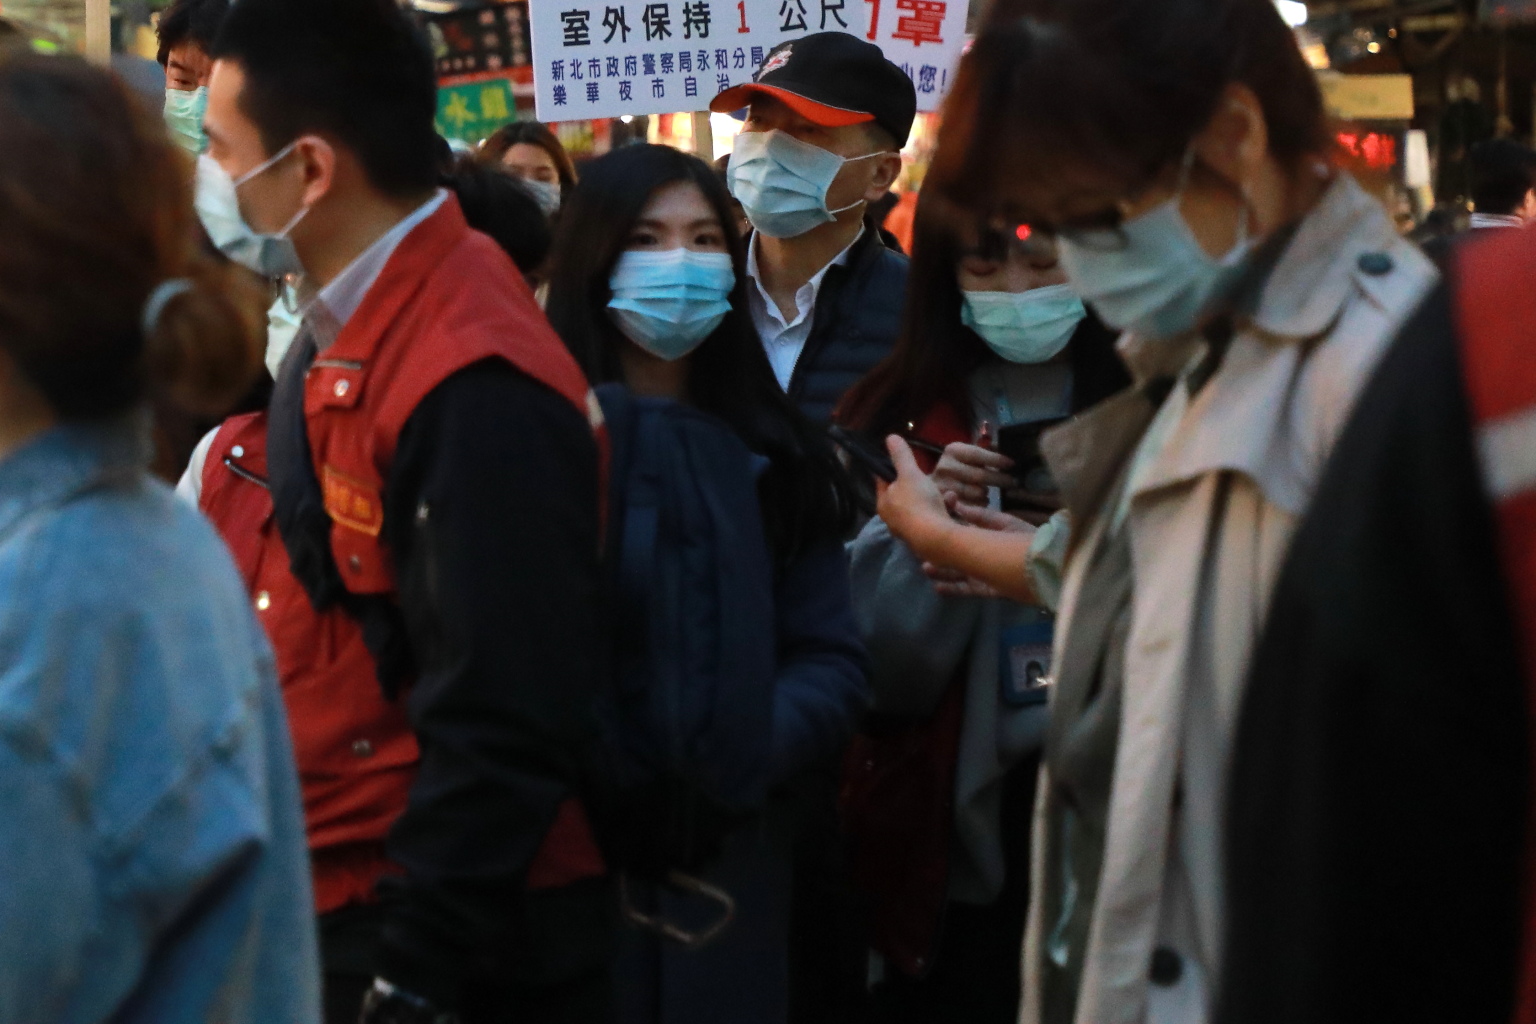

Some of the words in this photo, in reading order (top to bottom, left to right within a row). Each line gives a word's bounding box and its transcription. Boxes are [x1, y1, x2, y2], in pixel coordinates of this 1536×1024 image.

[552, 73, 759, 106] 樂華夜市自治
